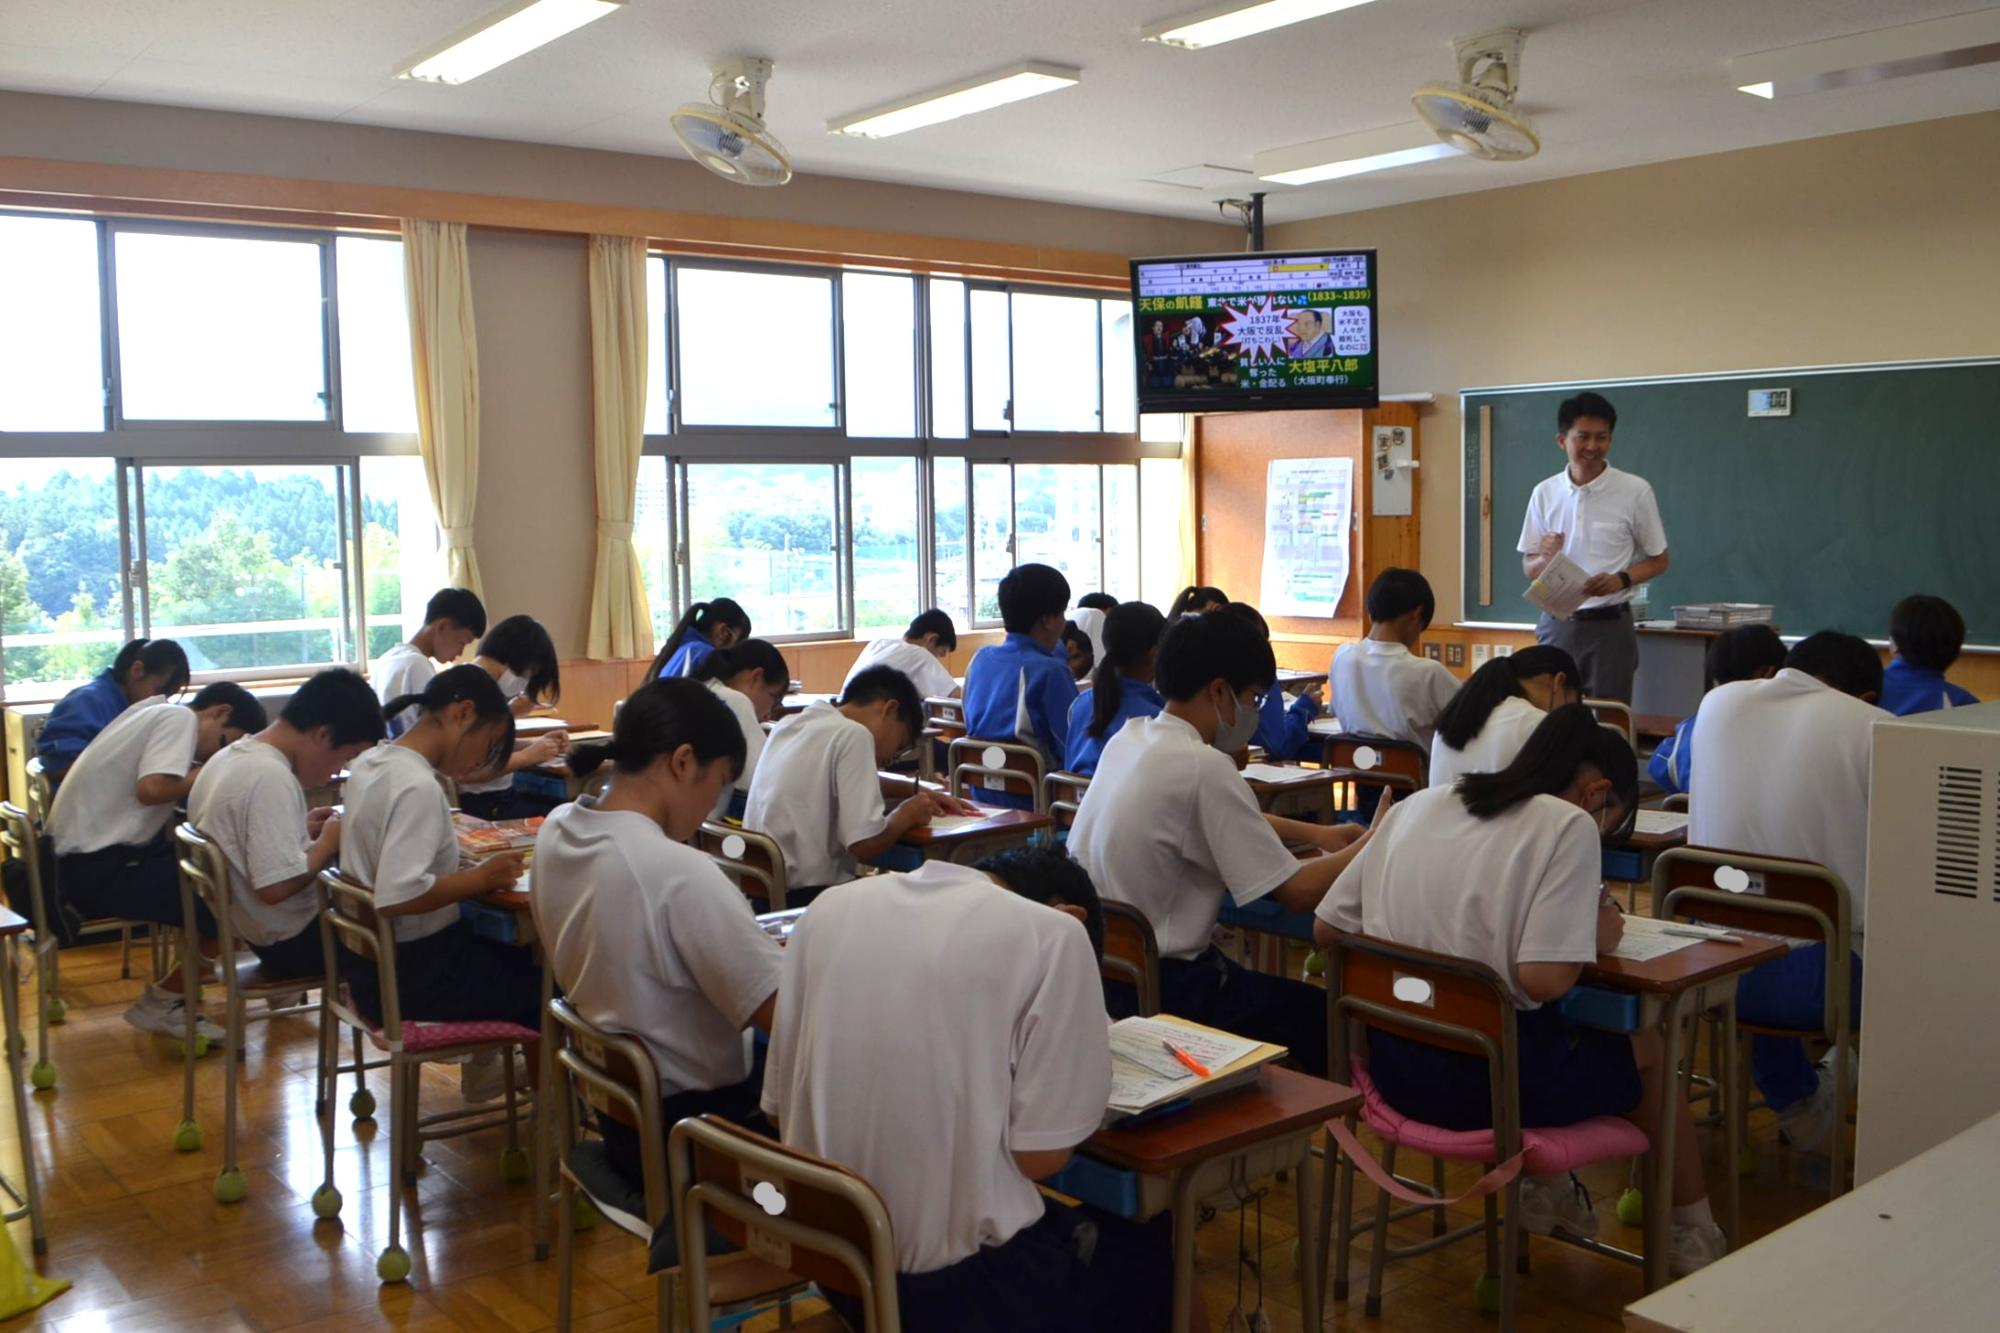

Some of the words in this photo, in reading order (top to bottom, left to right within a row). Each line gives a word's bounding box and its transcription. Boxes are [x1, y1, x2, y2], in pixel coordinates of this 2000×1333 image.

[1250, 315, 1280, 324] 1837年
[1288, 358, 1359, 374] 大塩平八郎
